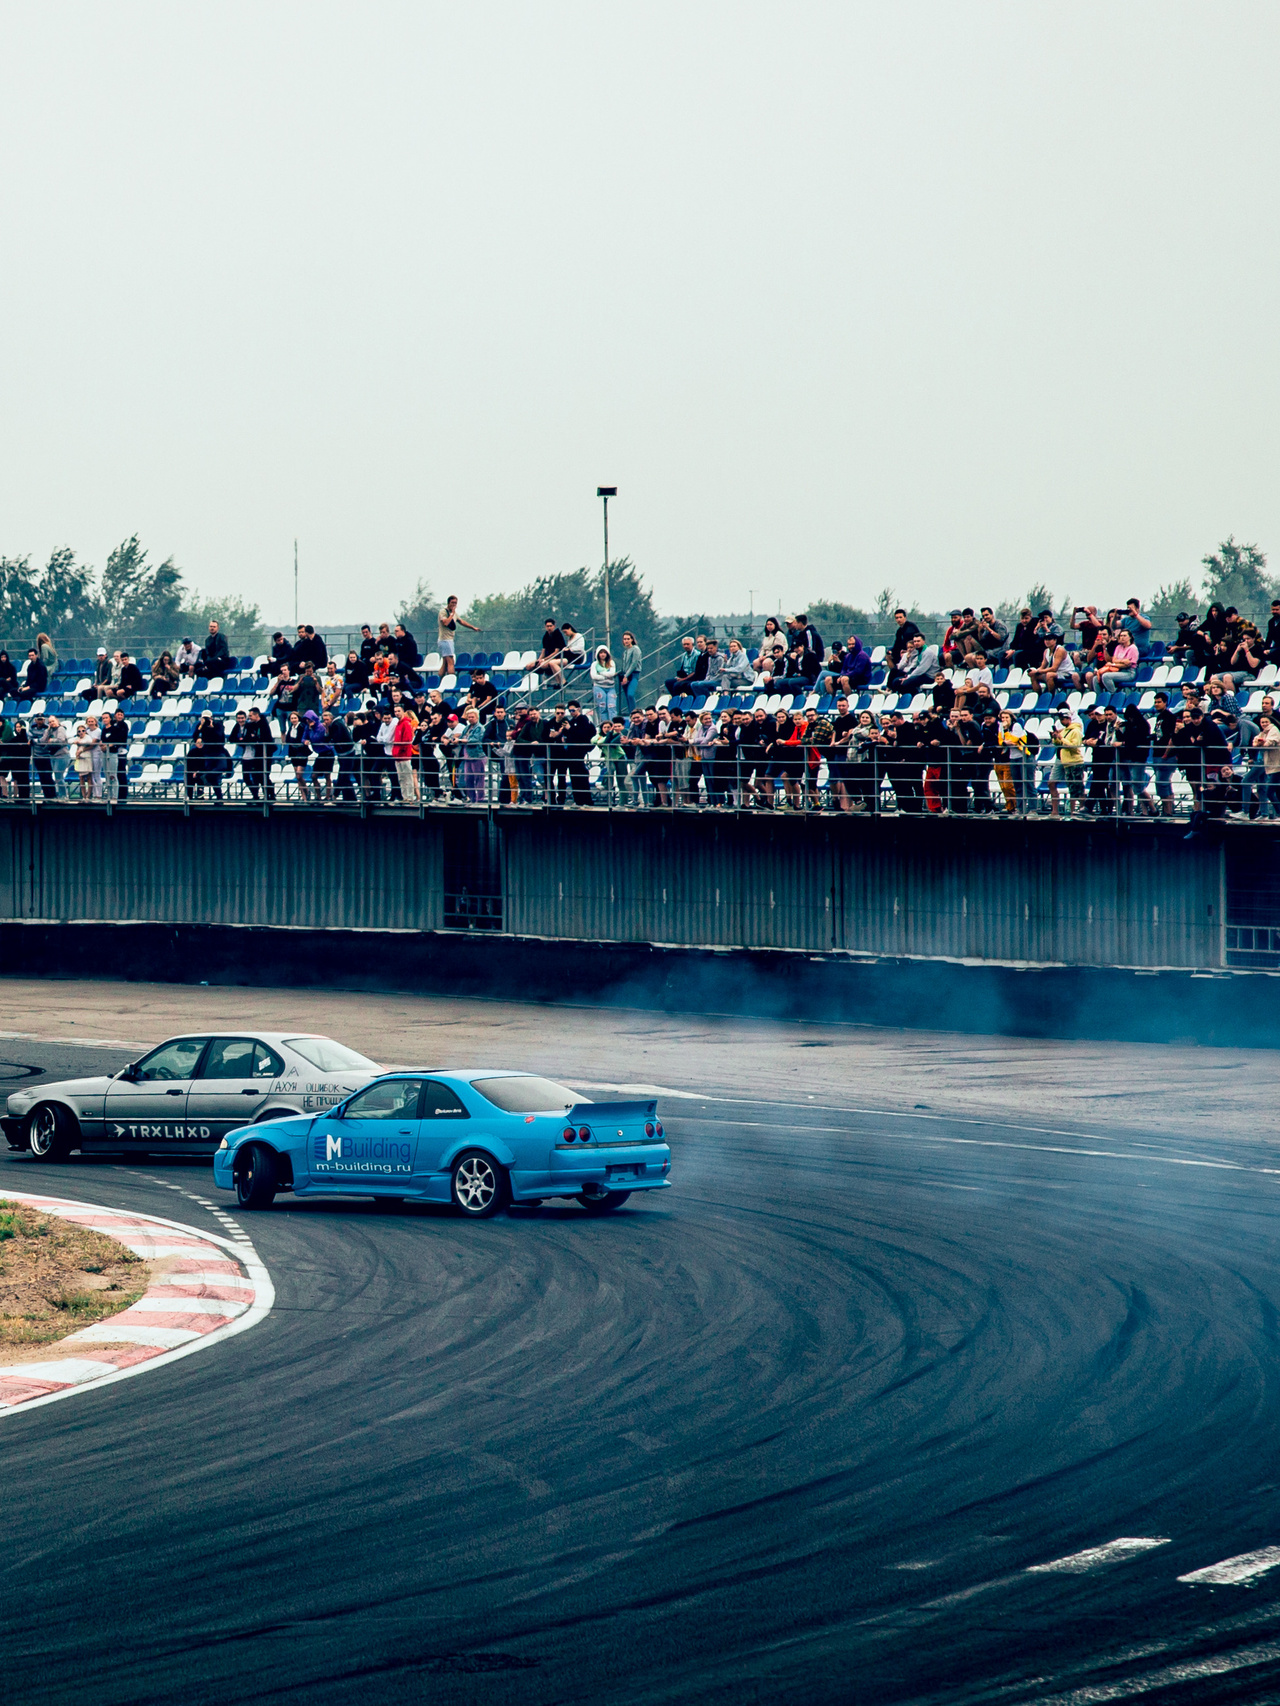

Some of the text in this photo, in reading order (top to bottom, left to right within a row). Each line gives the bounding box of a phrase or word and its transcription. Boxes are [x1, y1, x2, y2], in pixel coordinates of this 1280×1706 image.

[306, 1083, 340, 1093] ОШИБОК
[303, 1096, 314, 1108] НЕ
[128, 1125, 211, 1138] TRXLHXD
[316, 1162, 411, 1174] m-building.ru
